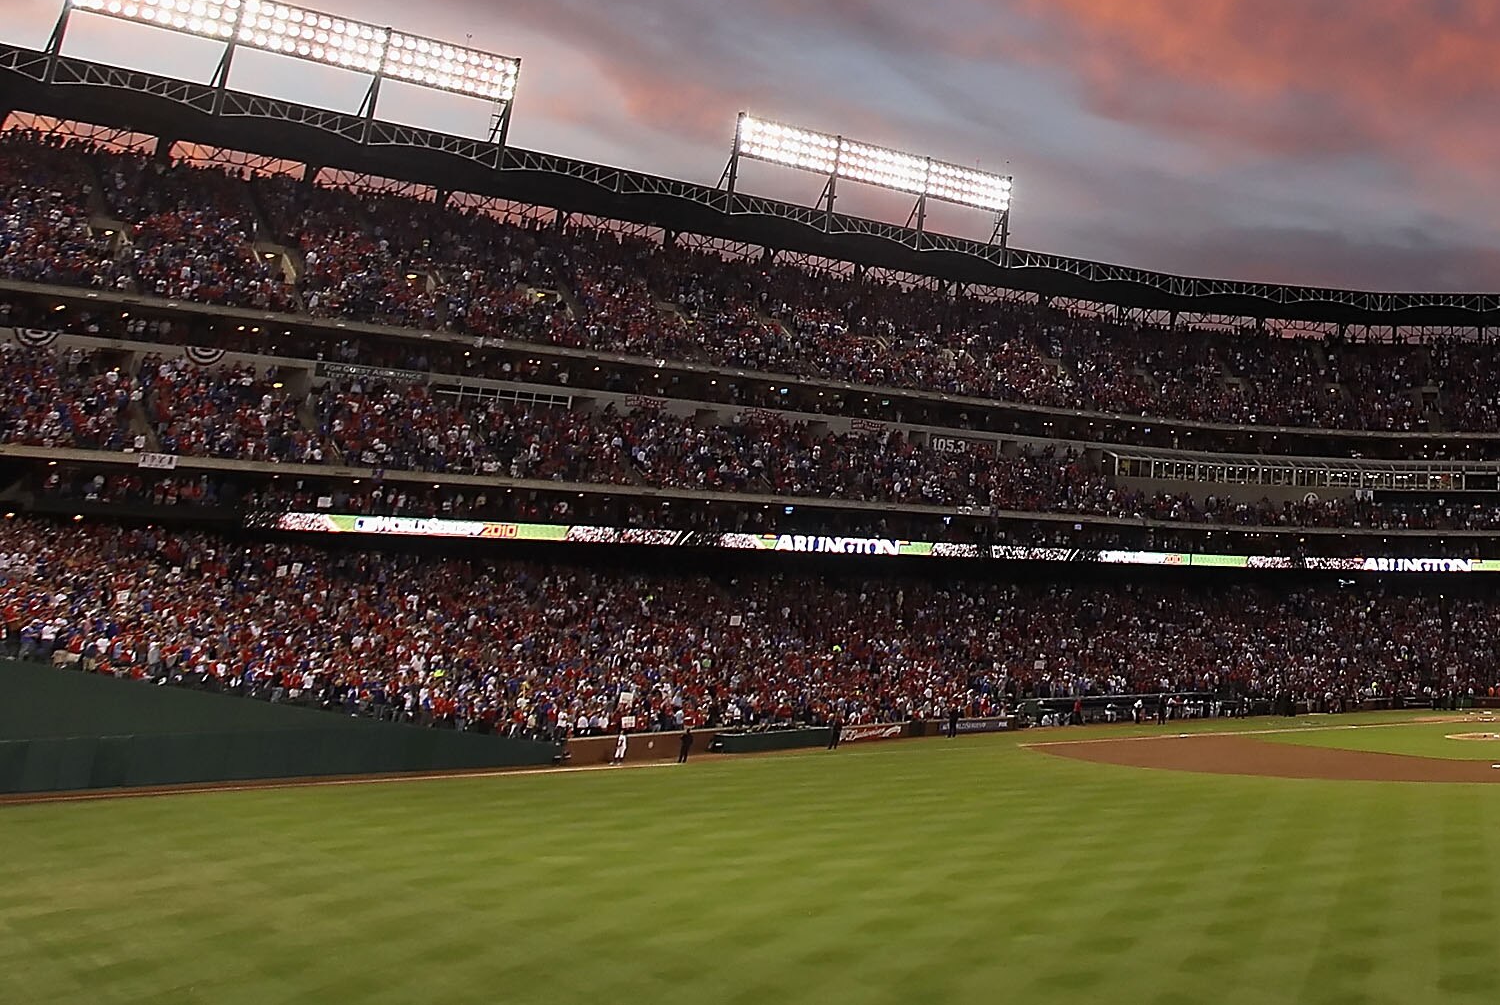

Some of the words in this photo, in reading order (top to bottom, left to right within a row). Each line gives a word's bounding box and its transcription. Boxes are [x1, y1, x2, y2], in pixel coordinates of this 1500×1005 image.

[932, 437, 966, 454] 105.3
[481, 523, 519, 538] 2010
[775, 534, 900, 555] ARLINGTON
[1363, 557, 1473, 572] ARLINGTON
